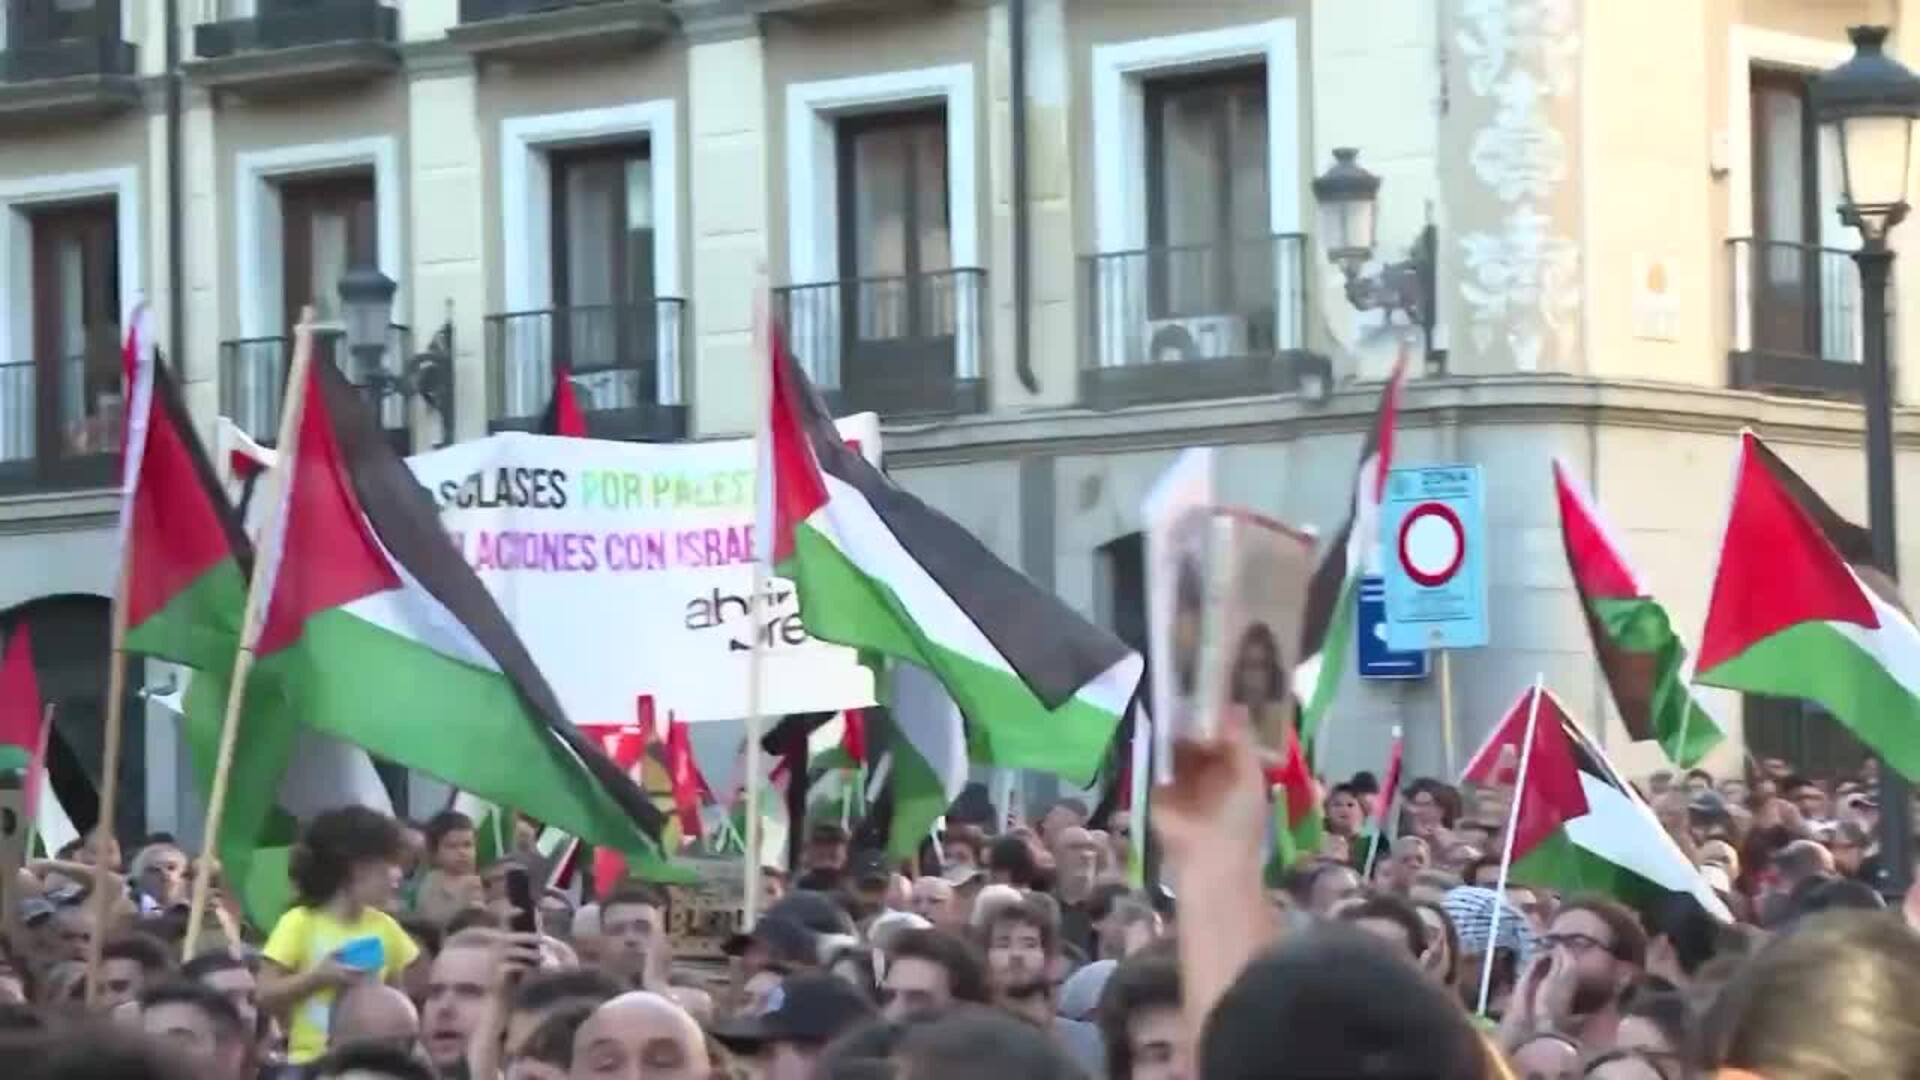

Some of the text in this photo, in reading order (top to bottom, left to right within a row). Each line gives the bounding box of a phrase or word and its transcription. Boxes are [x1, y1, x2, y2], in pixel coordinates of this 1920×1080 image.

[581, 470, 643, 510] POR
[652, 469, 760, 508] PALEST
[604, 531, 666, 571] CON
[676, 524, 761, 568] ISRAE
